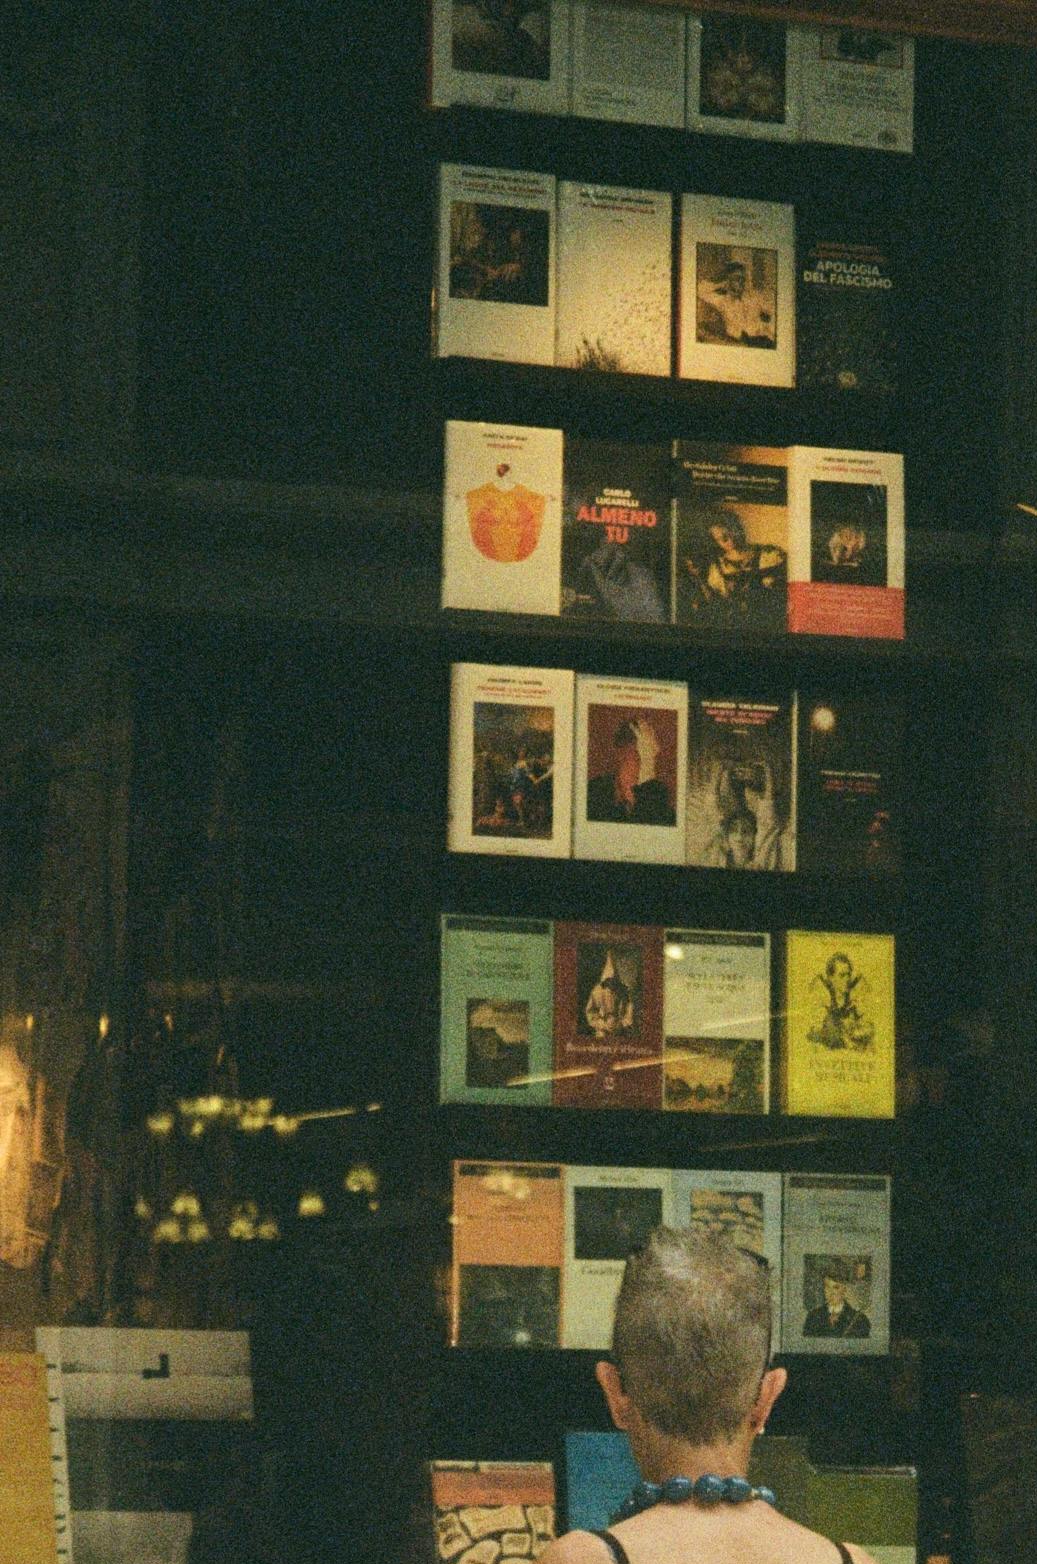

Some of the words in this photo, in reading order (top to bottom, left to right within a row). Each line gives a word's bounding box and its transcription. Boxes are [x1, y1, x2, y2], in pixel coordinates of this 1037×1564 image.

[816, 260, 880, 277] APOLOGIA
[802, 269, 828, 284] DEL
[829, 272, 893, 290] FASCISMO
[576, 504, 657, 528] ALMENO
[604, 525, 630, 545] TU
